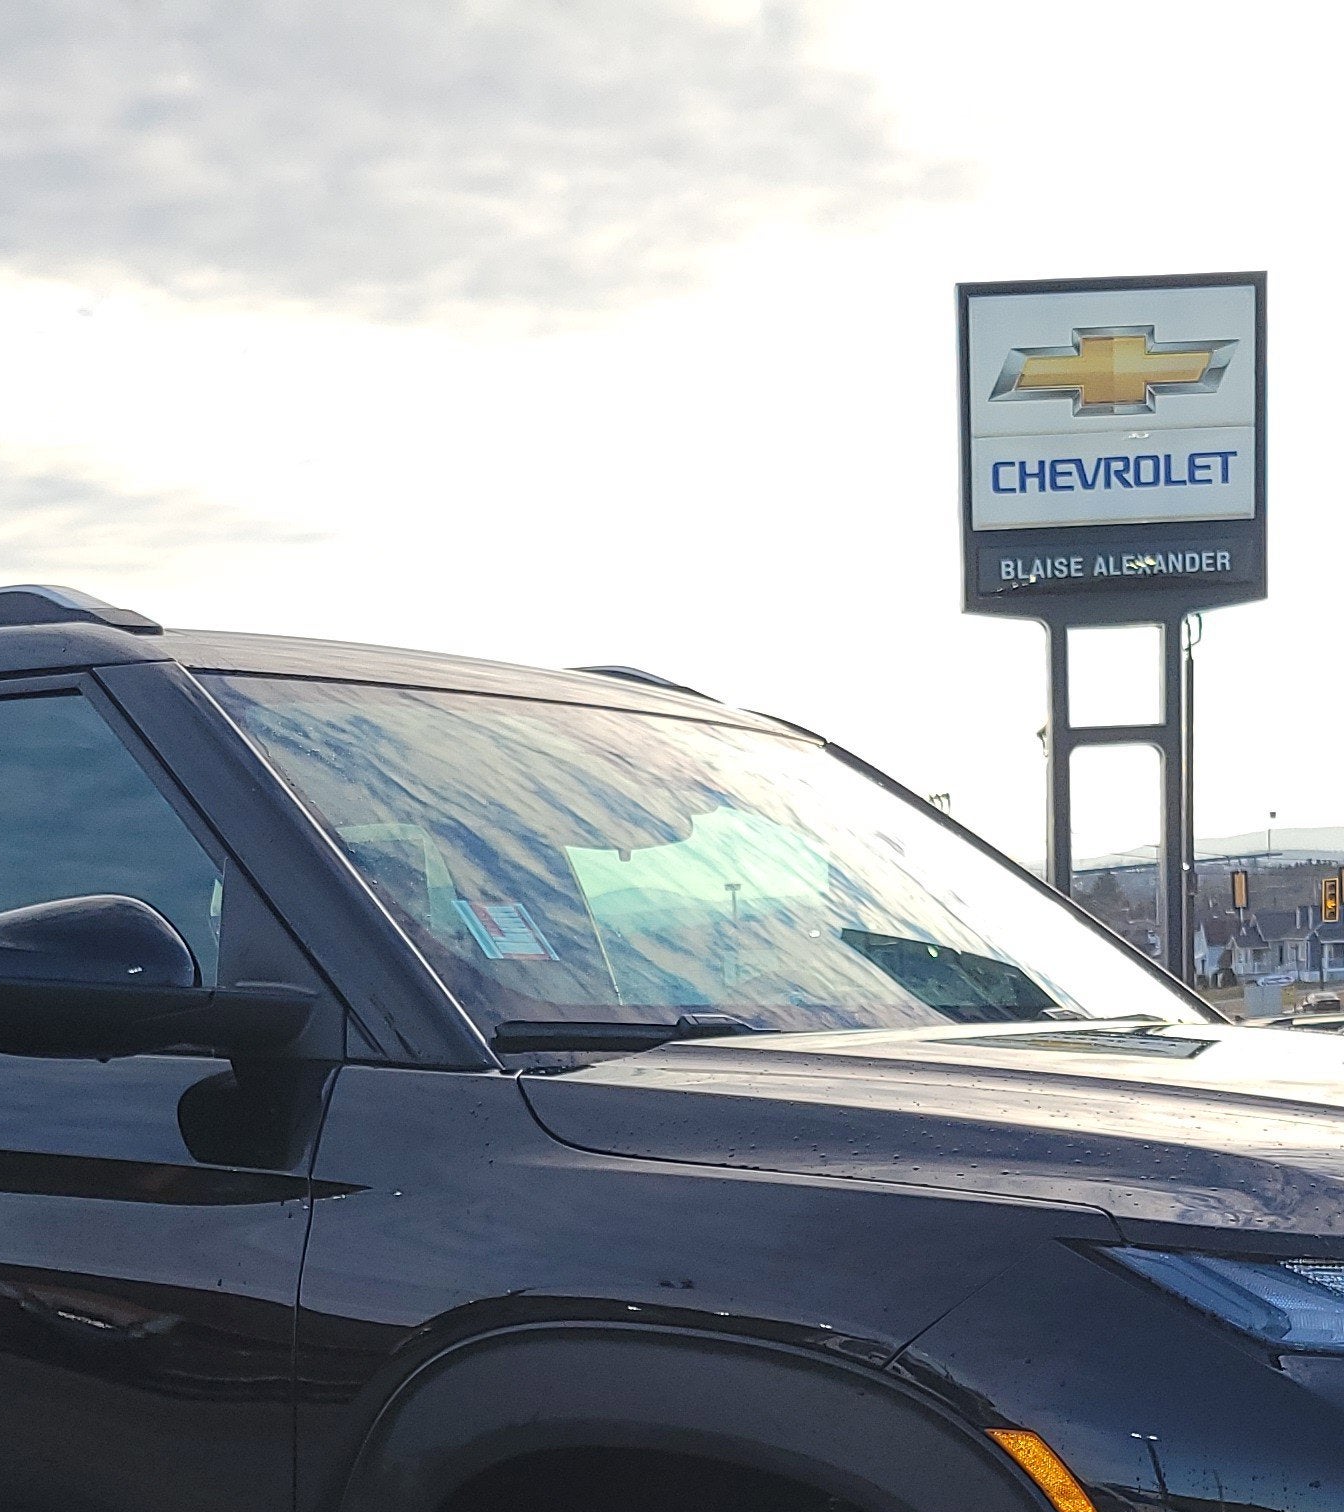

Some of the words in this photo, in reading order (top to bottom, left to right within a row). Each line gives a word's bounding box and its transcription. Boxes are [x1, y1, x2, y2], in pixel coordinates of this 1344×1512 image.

[991, 450, 1238, 495] CHEVROLET
[1000, 555, 1084, 581] BLAISE
[1093, 551, 1232, 577] ALEXANDER
